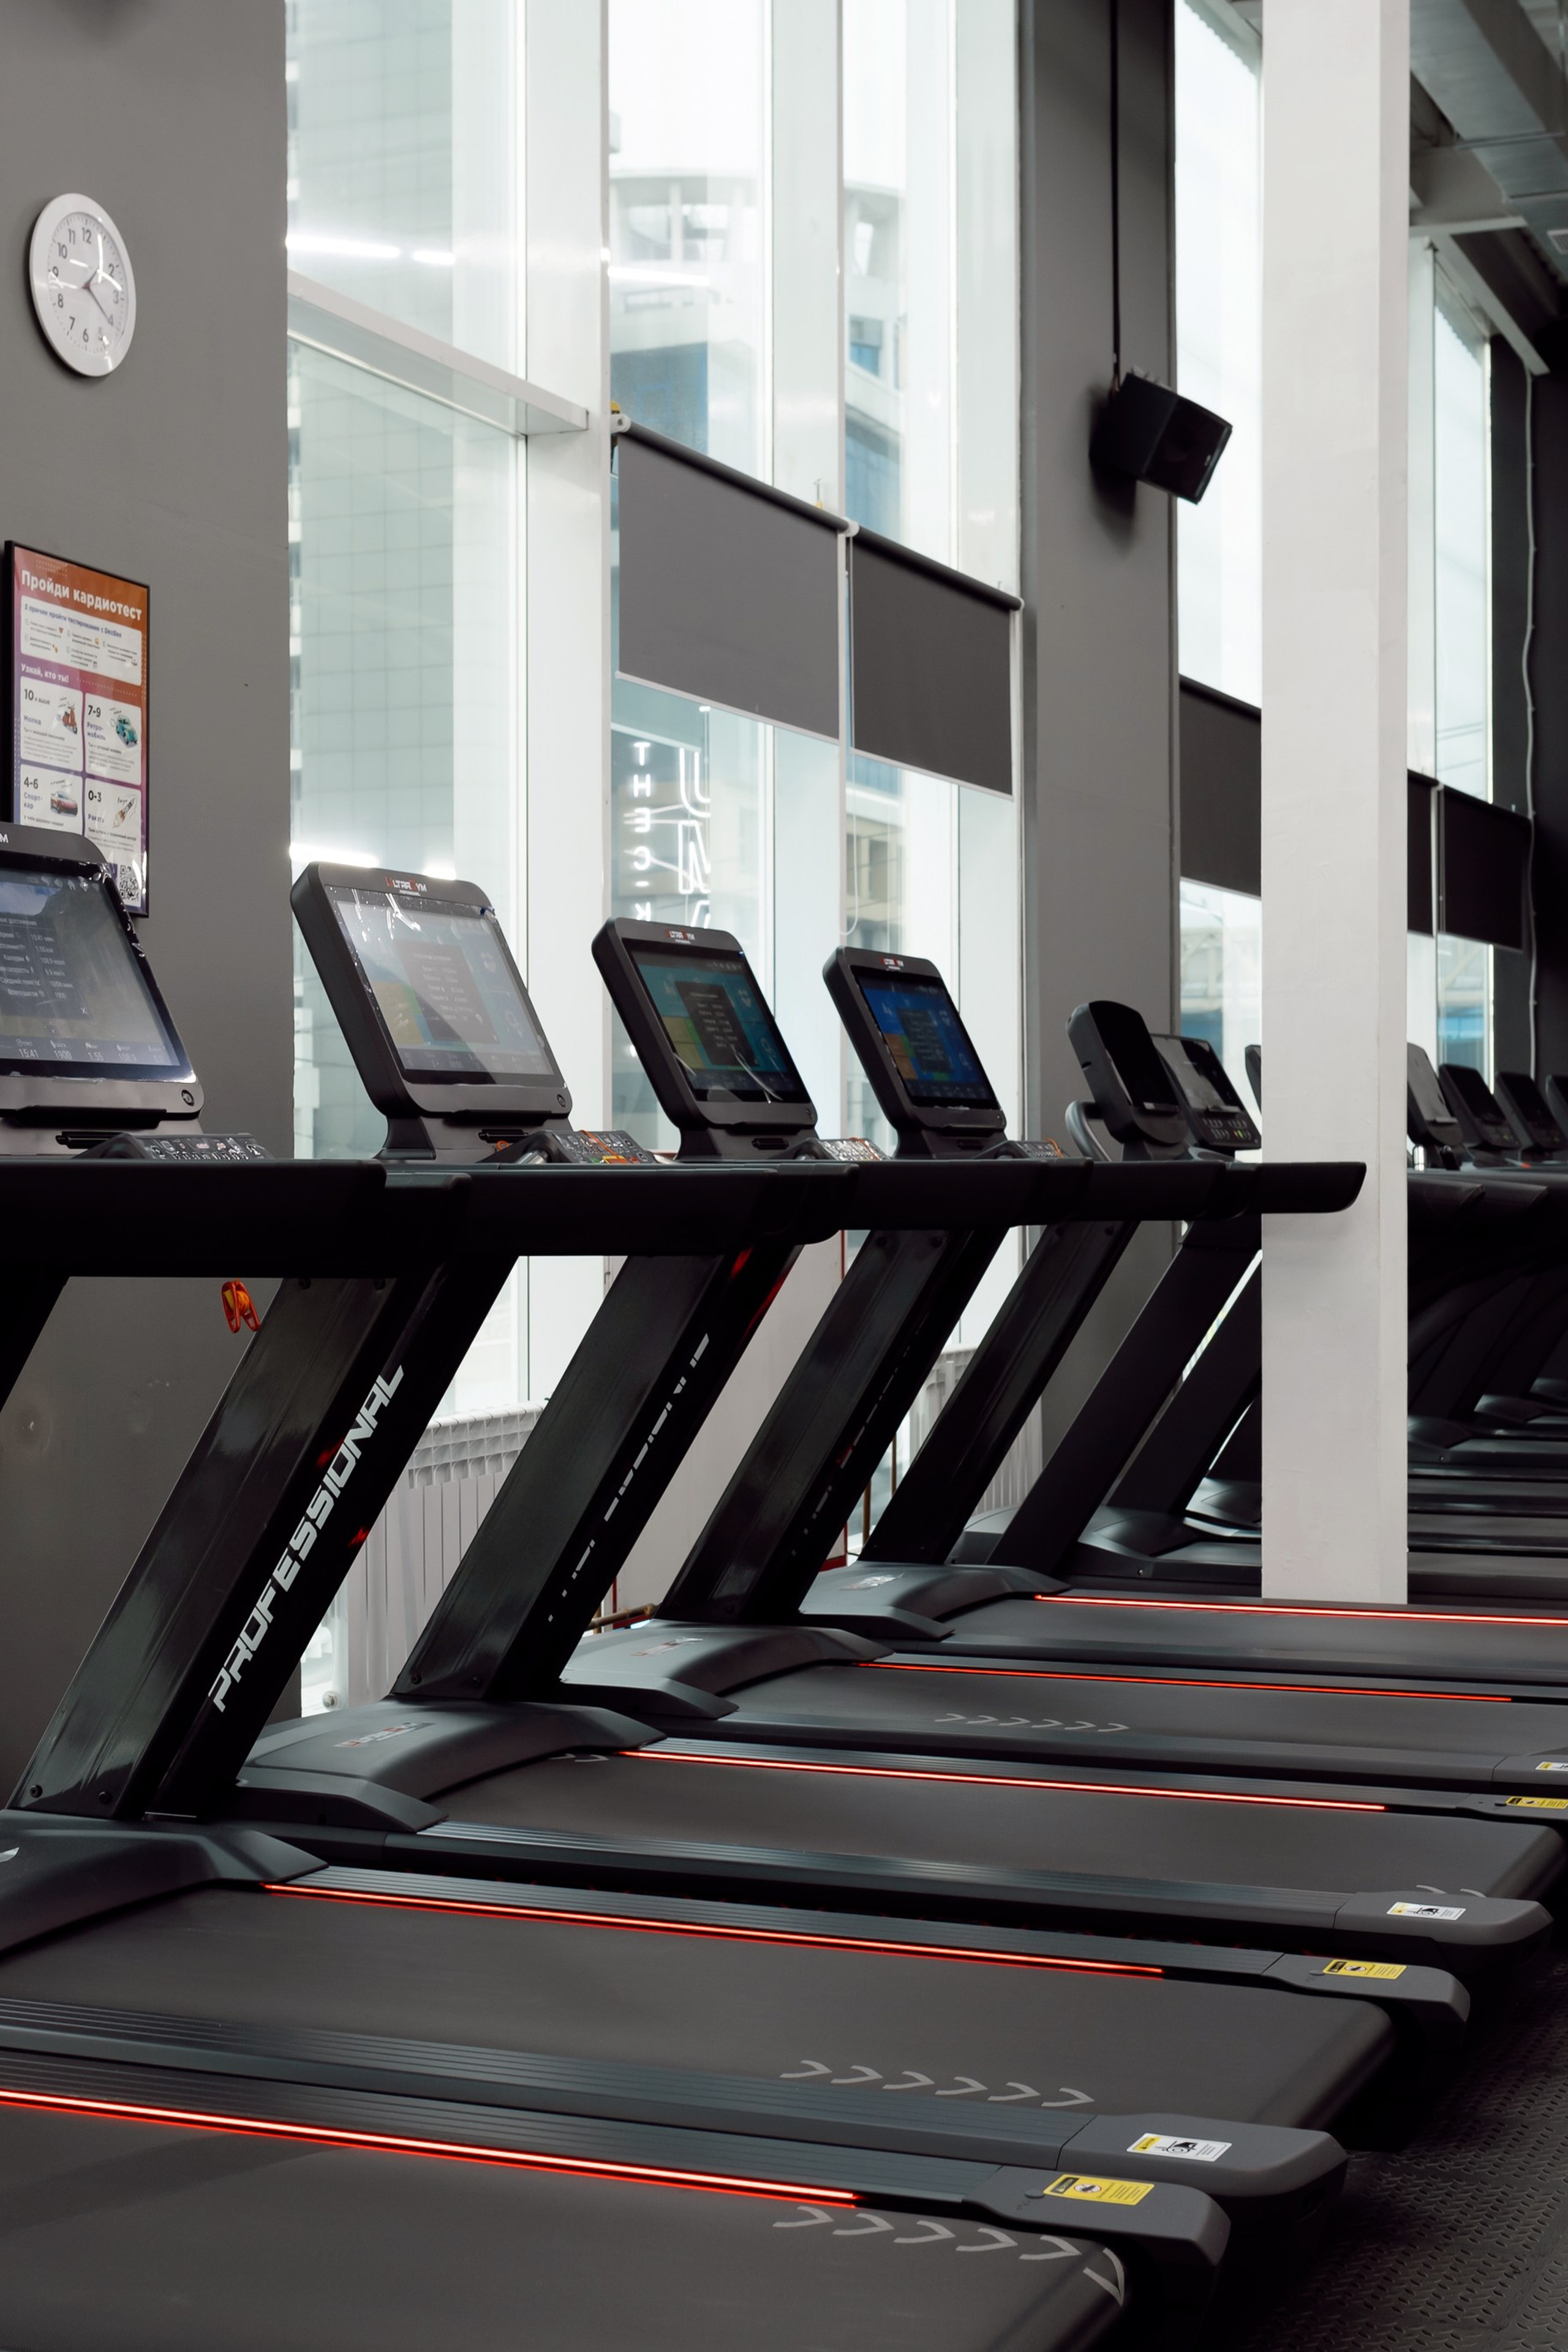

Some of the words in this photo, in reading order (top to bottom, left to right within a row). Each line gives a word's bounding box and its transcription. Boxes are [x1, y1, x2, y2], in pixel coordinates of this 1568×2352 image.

[68, 228, 76, 245] 11
[81, 227, 91, 244] 12
[58, 242, 67, 259] 10
[53, 266, 59, 280] 9
[108, 263, 115, 277] 2
[58, 293, 64, 309] 8
[113, 290, 119, 304] 3
[69, 317, 75, 330] 7
[83, 328, 89, 343] 6
[21, 570, 70, 599] Пройди
[73, 589, 142, 621] кардиотест
[21, 663, 43, 677] Узнай,
[44, 670, 56, 680] кто
[58, 674, 69, 684] ты!
[24, 688, 34, 701] 10
[88, 704, 101, 718] 7-9
[24, 777, 39, 790] 4-6
[88, 790, 102, 802] 0-3
[18, 1049, 39, 1059] 15:41
[208, 1365, 404, 1713] PROFESSIONAL
